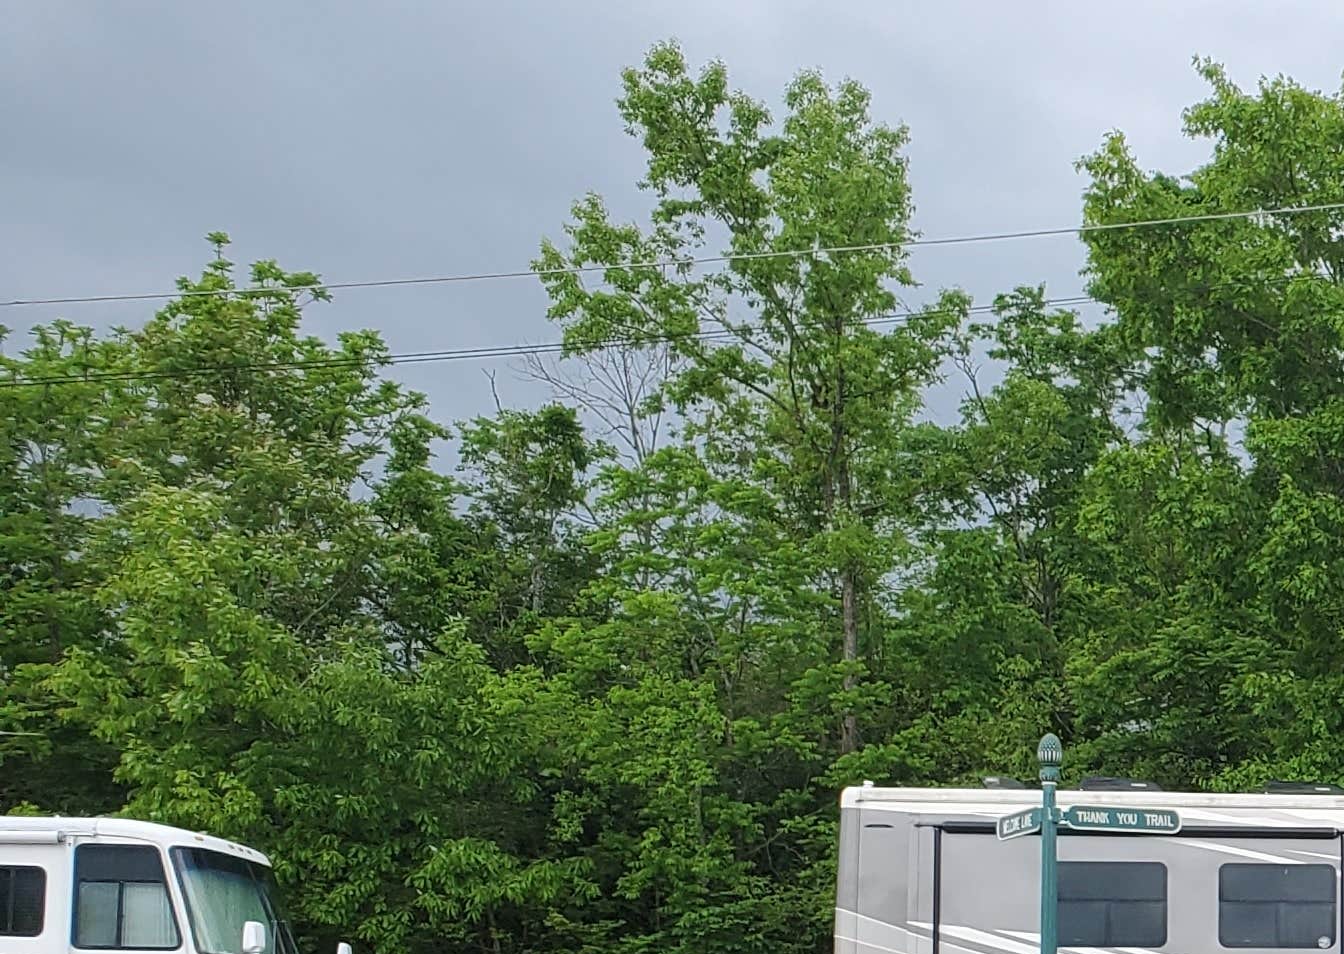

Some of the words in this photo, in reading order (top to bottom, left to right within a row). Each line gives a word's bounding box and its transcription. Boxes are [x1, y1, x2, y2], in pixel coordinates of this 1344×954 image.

[1076, 811, 1110, 824] THANK
[1116, 812, 1137, 825] YOU
[1144, 813, 1174, 827] TRAIL
